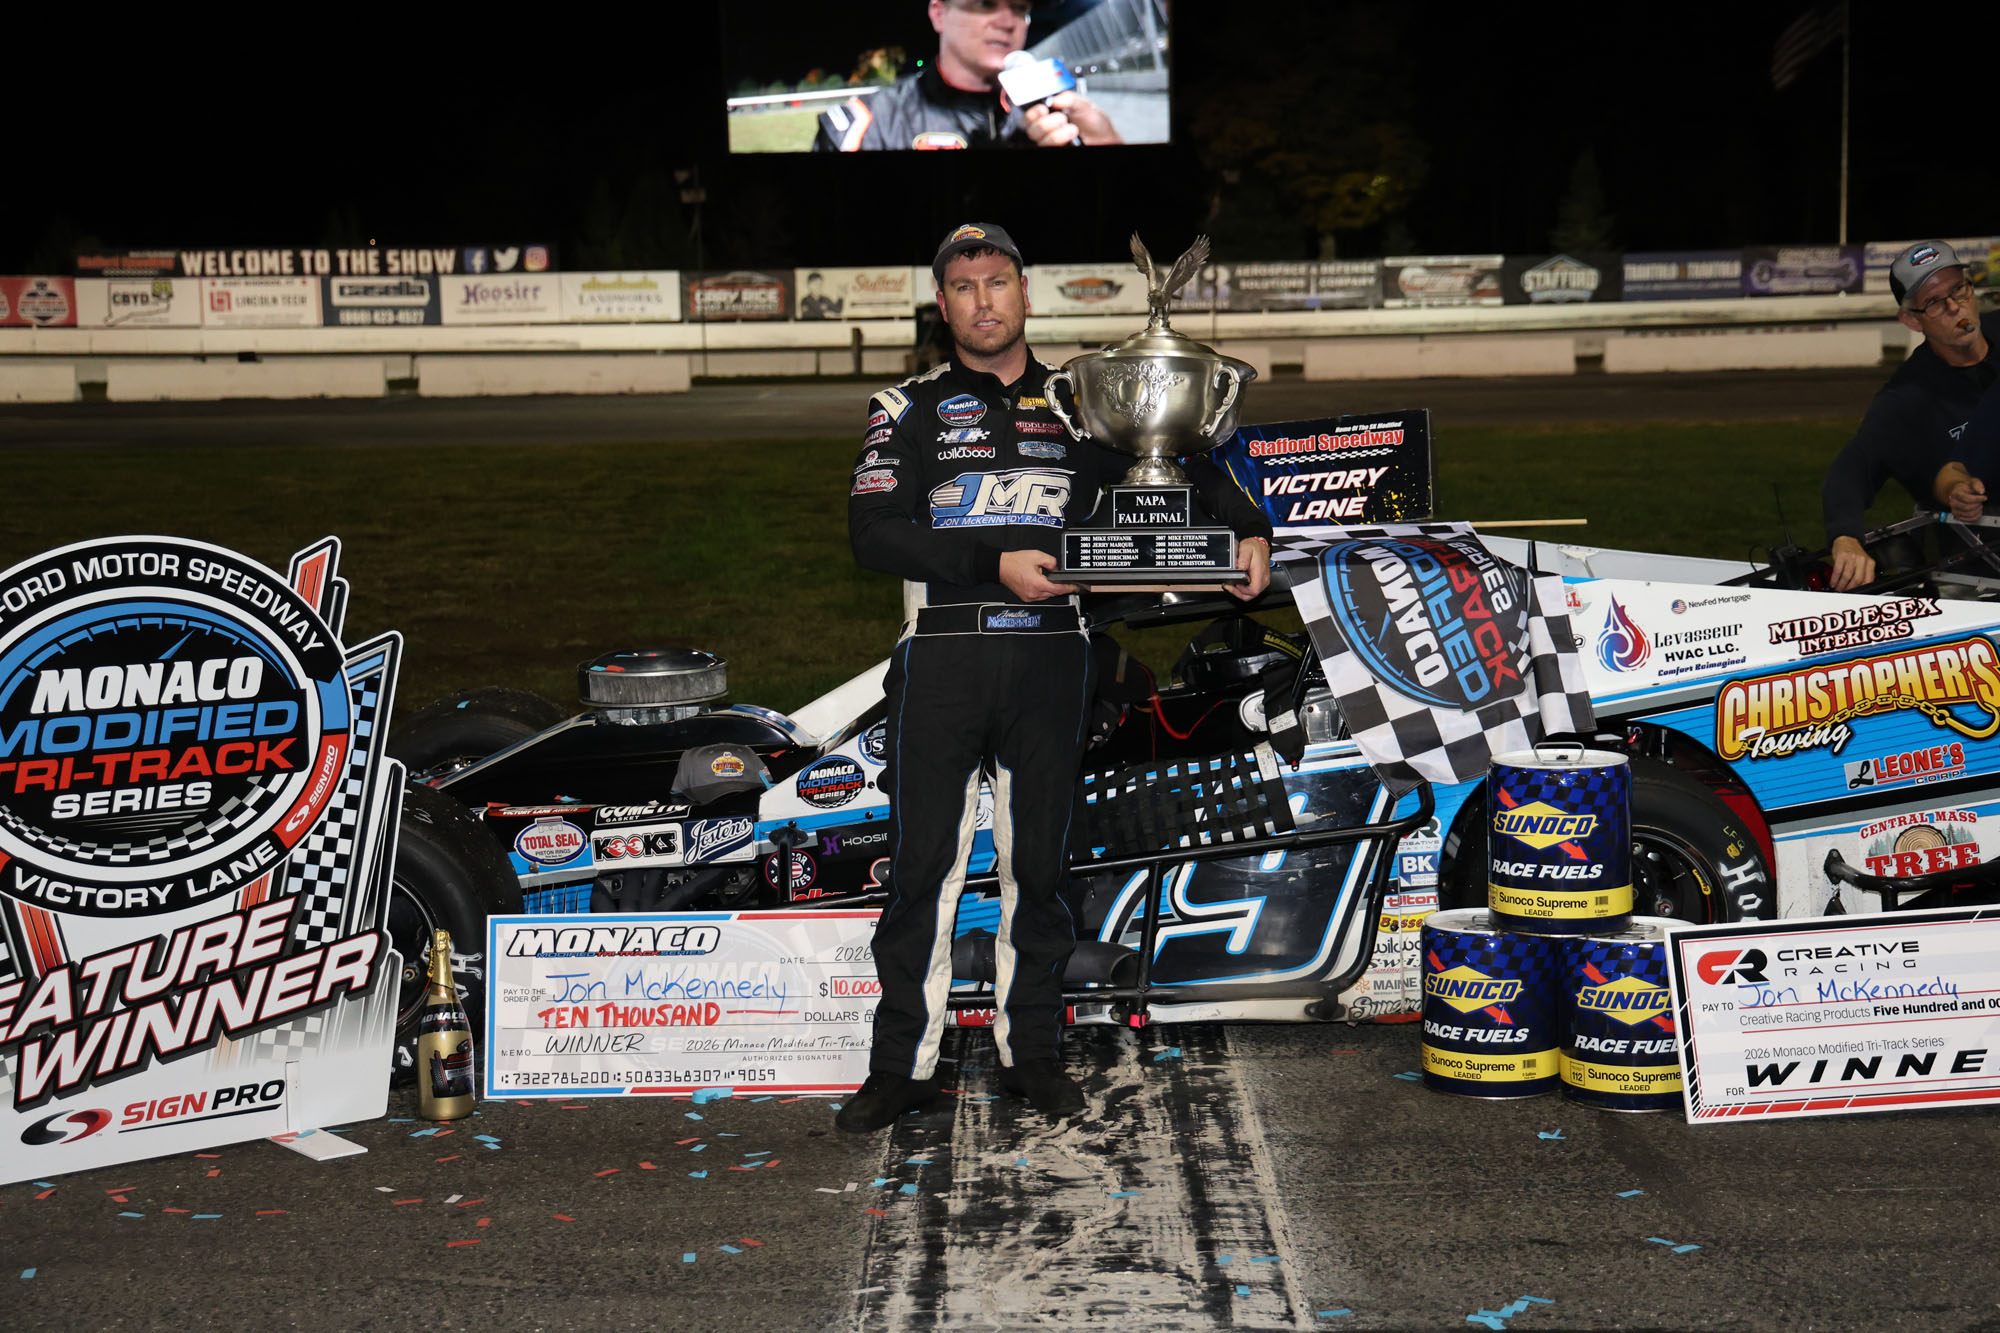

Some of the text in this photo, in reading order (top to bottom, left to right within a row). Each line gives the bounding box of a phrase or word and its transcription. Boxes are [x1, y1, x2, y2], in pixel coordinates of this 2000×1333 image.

[180, 250, 294, 276] WELCOME
[300, 250, 330, 276] TO
[336, 249, 380, 275] THE
[386, 249, 456, 275] SHOW
[462, 281, 542, 305] Hoosier
[941, 405, 984, 413] MODIFIED
[948, 401, 978, 409] MONACO
[938, 447, 995, 460] wildwood
[1249, 429, 1404, 457] Stafford Speedway
[1263, 466, 1389, 497] VICTORY
[1135, 495, 1166, 506] NAPA
[1286, 496, 1368, 522] LANE
[940, 515, 1057, 526] JON McKENNEDY RACING
[1118, 512, 1184, 524] FALL FINAL
[73, 552, 180, 585] MOTOR
[186, 558, 325, 653] SPEEDWAY
[1688, 593, 1751, 609] NewFed Mortgage
[1769, 597, 1942, 644] MIDDLESEX
[1654, 623, 1743, 649] Levasseur
[1799, 622, 1913, 656] INTERIORS
[1665, 643, 1739, 662] HVAC LLC.
[1658, 656, 1747, 677] Comfort Reimagined
[30, 657, 263, 714] MONACO
[1720, 642, 2000, 755] CHRISTOPHER'S
[0, 700, 299, 758] MODIFIED
[1738, 722, 1852, 759] Towing
[809, 765, 855, 780] MONACO
[1873, 742, 1966, 779] LEONE'S
[308, 744, 337, 804] SIGN PRO
[799, 773, 863, 789] MODIFIED
[51, 781, 212, 819] SERIES
[800, 781, 863, 796] TRI-TRACK
[814, 791, 845, 800] SERIES
[1494, 812, 1594, 836] SUNOCO
[1861, 811, 1977, 839] CENTRAL MASS
[523, 833, 580, 850] TOTAL SEAL
[594, 831, 677, 862] KOOKS
[690, 816, 753, 863] Jostens
[1402, 855, 1434, 873] BK
[1492, 859, 1604, 880] RACE FUELS
[1865, 842, 1979, 878] TREE
[14, 840, 279, 909] VICTORY LANE
[1387, 895, 1437, 907] tilton
[1499, 892, 1588, 912] Sunoco Supreme
[1524, 909, 1554, 917] LEADED
[506, 927, 721, 957] MONACO
[1777, 940, 1920, 962] CREATIVE
[780, 946, 873, 964] DATE 2026
[0, 896, 296, 1043] EATURE
[1784, 959, 1917, 976] RACING
[545, 968, 787, 1017] Jon McKennedy
[819, 982, 829, 998] $
[1374, 977, 1417, 990] MAINE
[1426, 975, 1518, 1000] SUNOCO
[1738, 975, 1959, 1008] Jon McKennedy
[19, 931, 380, 1104] WINNER
[538, 1000, 721, 1029] TEN THOUSAND
[804, 1011, 859, 1023] DOLLARS
[1702, 1002, 1734, 1012] PAY TO
[1740, 998, 1985, 1026] Creative Racing Products Five Hundred and
[1423, 1018, 1530, 1043] RACE FUELS
[545, 1033, 645, 1055] WINNER
[686, 1035, 866, 1052] 2026 Monaco Modified Tri-Track
[1744, 1036, 1945, 1061] 2026 Monaco Modified Tri-Track Series
[742, 1054, 794, 1062] AUTHORIZED
[1431, 1053, 1516, 1074] Sunoco Supreme
[1746, 1048, 2000, 1087] WINNE
[1453, 1071, 1482, 1080] LEADED
[1572, 1072, 1582, 1081] 112
[121, 1079, 285, 1125] SIGN PRO
[1726, 1087, 1745, 1096] FOR
